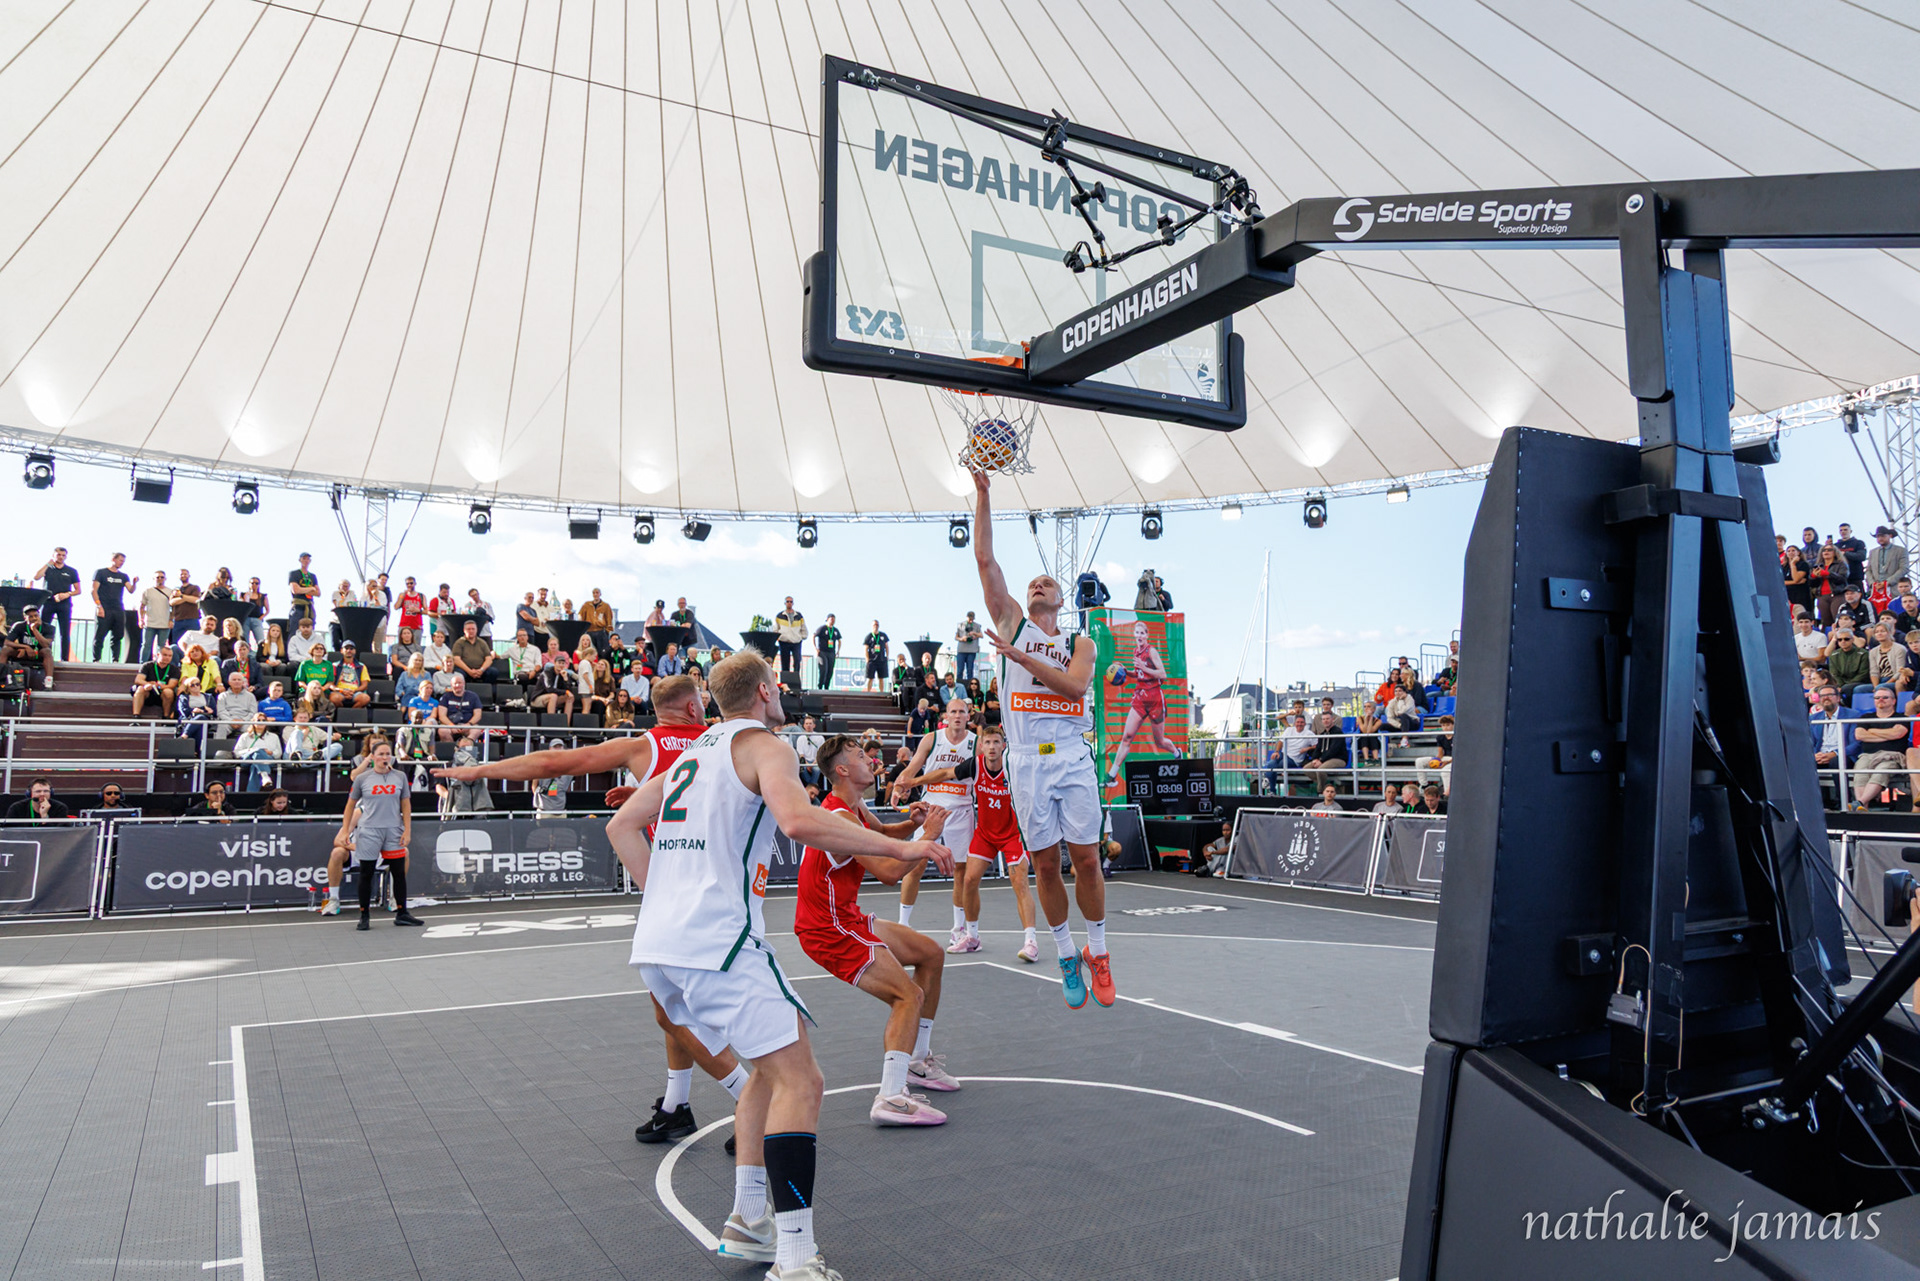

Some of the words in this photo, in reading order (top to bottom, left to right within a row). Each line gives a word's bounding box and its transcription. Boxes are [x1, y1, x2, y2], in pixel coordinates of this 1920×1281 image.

[1377, 201, 1473, 223] Schelde
[1478, 199, 1572, 228] Sports
[1498, 224, 1528, 234] Superior
[1529, 224, 1540, 235] by
[1540, 223, 1567, 235] Design
[1061, 262, 1199, 354] COPENHAGEN
[1013, 695, 1081, 713] betsson
[661, 758, 700, 823] 2
[928, 784, 966, 794] betsson
[1134, 783, 1148, 795] 18
[1156, 784, 1183, 794] 03:09
[1190, 781, 1207, 793] 09
[988, 797, 1002, 810] 24
[220, 834, 292, 859] visit
[1277, 854, 1289, 873] CITY
[145, 863, 351, 895] copenhage
[504, 873, 545, 884] SPORT
[549, 872, 559, 882] &
[563, 871, 585, 882] LEG
